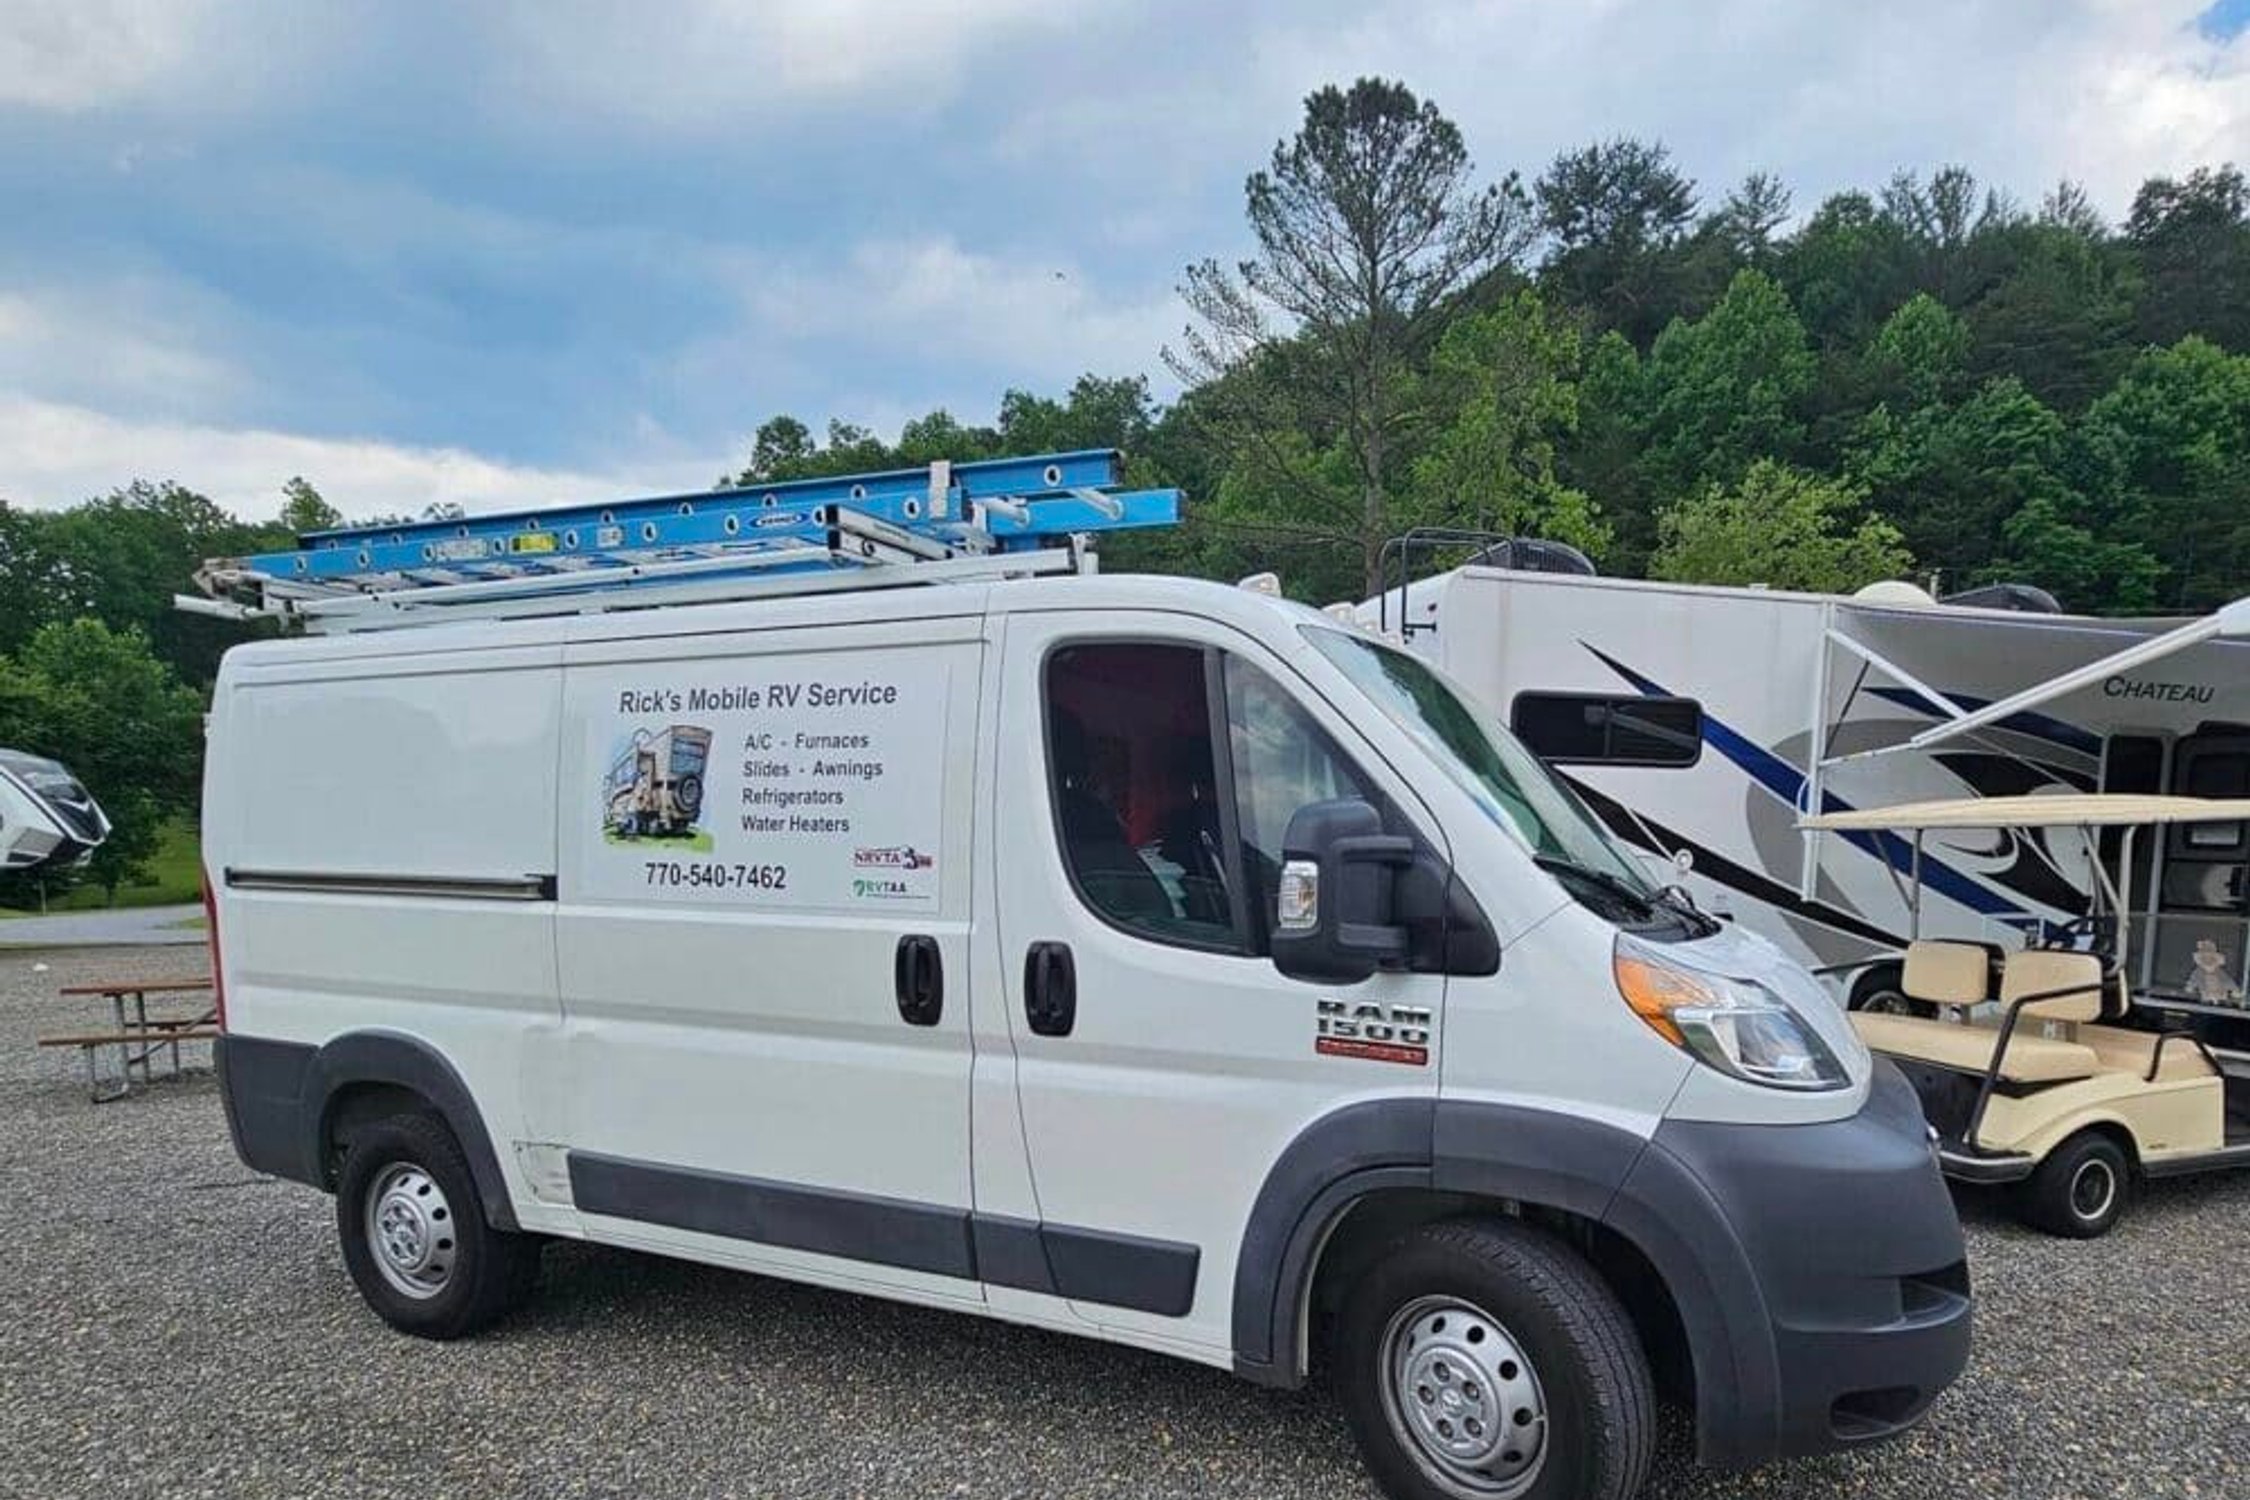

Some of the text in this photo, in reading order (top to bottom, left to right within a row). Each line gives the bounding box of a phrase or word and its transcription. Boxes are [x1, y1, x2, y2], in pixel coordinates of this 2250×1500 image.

[620, 680, 897, 713] Rick's Mobile RV Service
[2103, 675, 2216, 703] CHATEAU
[744, 733, 772, 751] A/C
[794, 732, 869, 749] Furnaces
[743, 760, 790, 778] Slides
[813, 760, 883, 780] Awnings
[742, 787, 844, 809] Refrigerators
[742, 815, 850, 832] Water Heaters
[645, 862, 786, 889] 770-540-7462
[1317, 998, 1431, 1025] RAM
[1317, 1017, 1428, 1044] 1500
